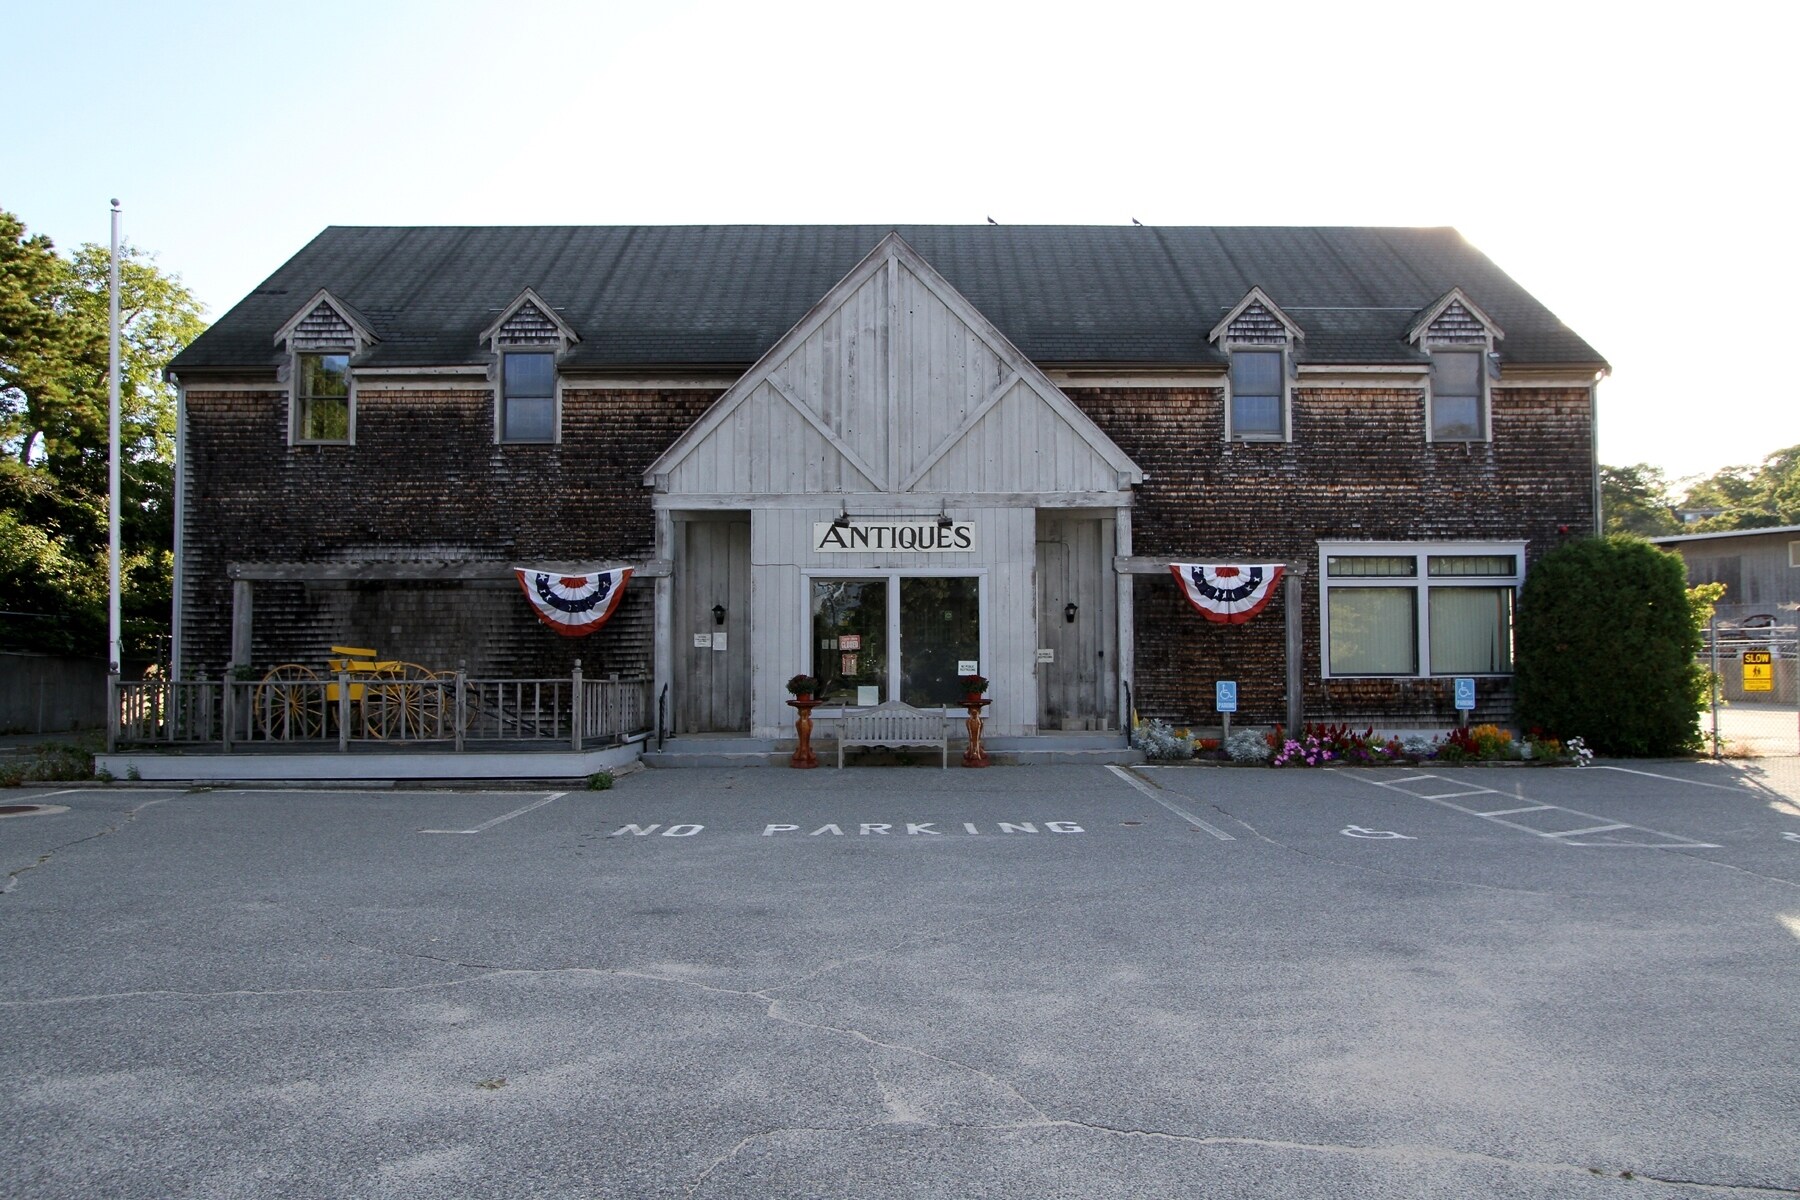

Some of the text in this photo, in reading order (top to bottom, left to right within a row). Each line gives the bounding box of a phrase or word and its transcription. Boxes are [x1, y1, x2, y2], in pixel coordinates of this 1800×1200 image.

[818, 524, 971, 551] ANTIQUES
[1745, 653, 1769, 662] SLOW
[611, 821, 1085, 837] NO PARKING
